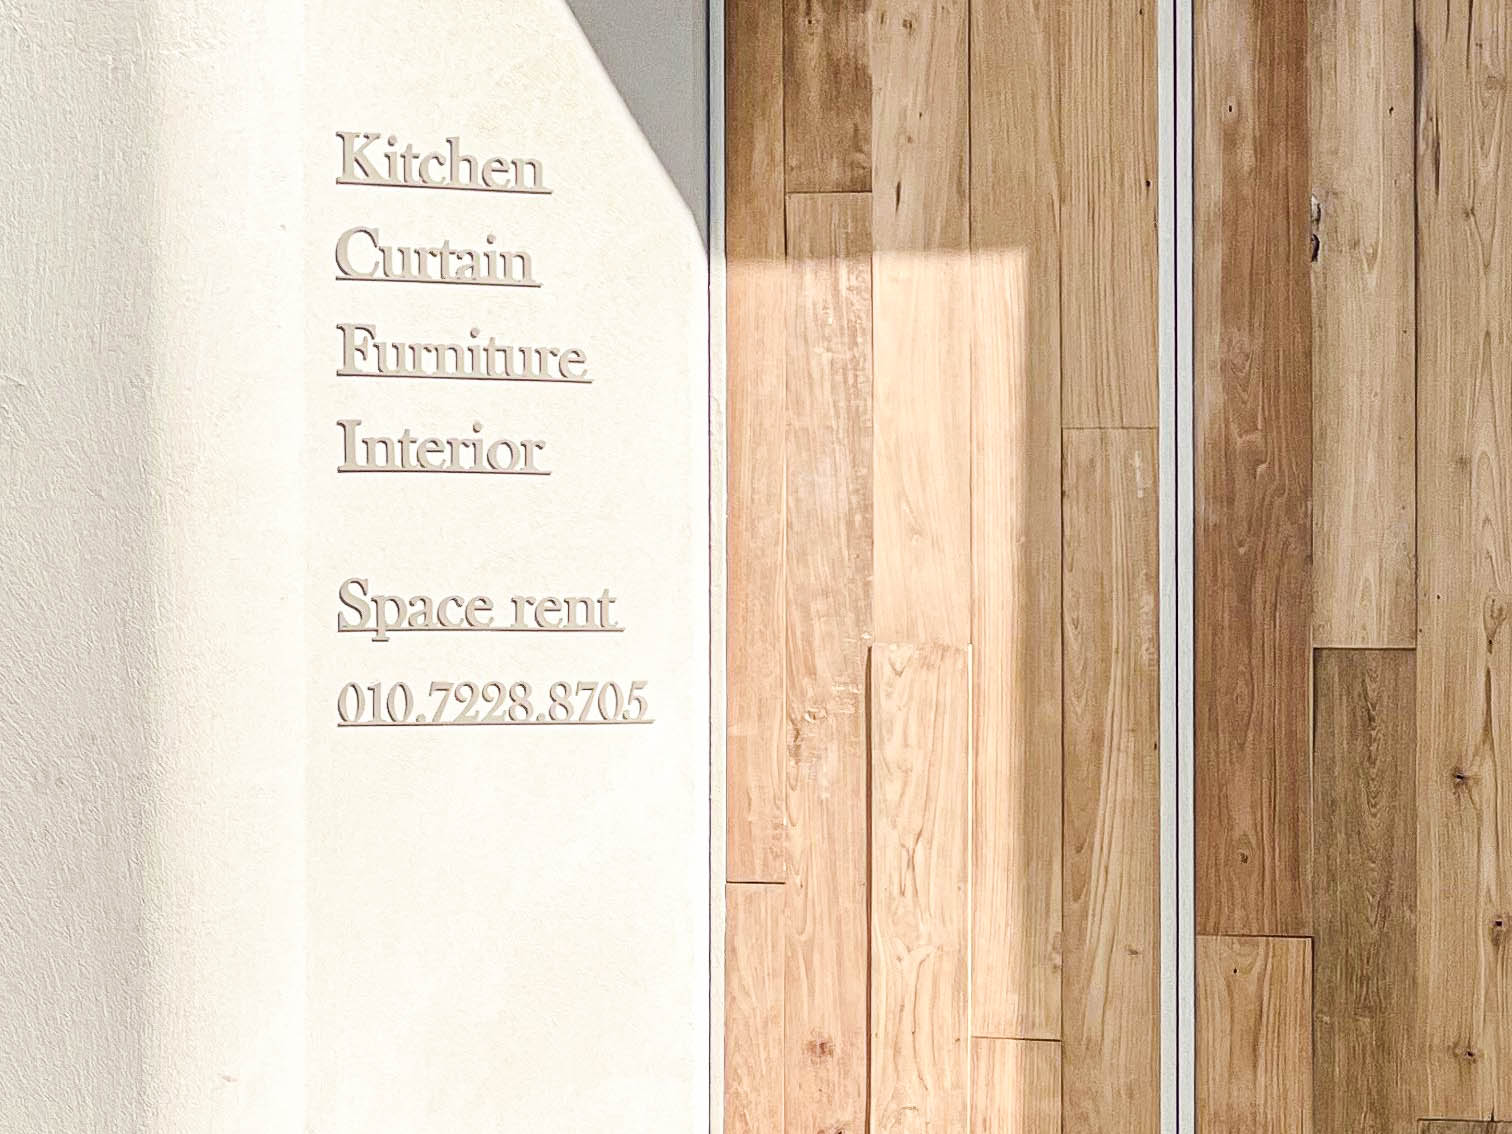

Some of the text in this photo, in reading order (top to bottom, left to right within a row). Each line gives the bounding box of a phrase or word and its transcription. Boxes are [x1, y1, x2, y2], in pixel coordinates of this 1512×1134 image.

[336, 131, 549, 190] Kitchen
[335, 226, 538, 284] Curtain
[336, 323, 589, 379] Furniture
[337, 419, 548, 471] Interior
[338, 577, 620, 642] Space rent
[337, 680, 650, 724] 010.7228.8705
